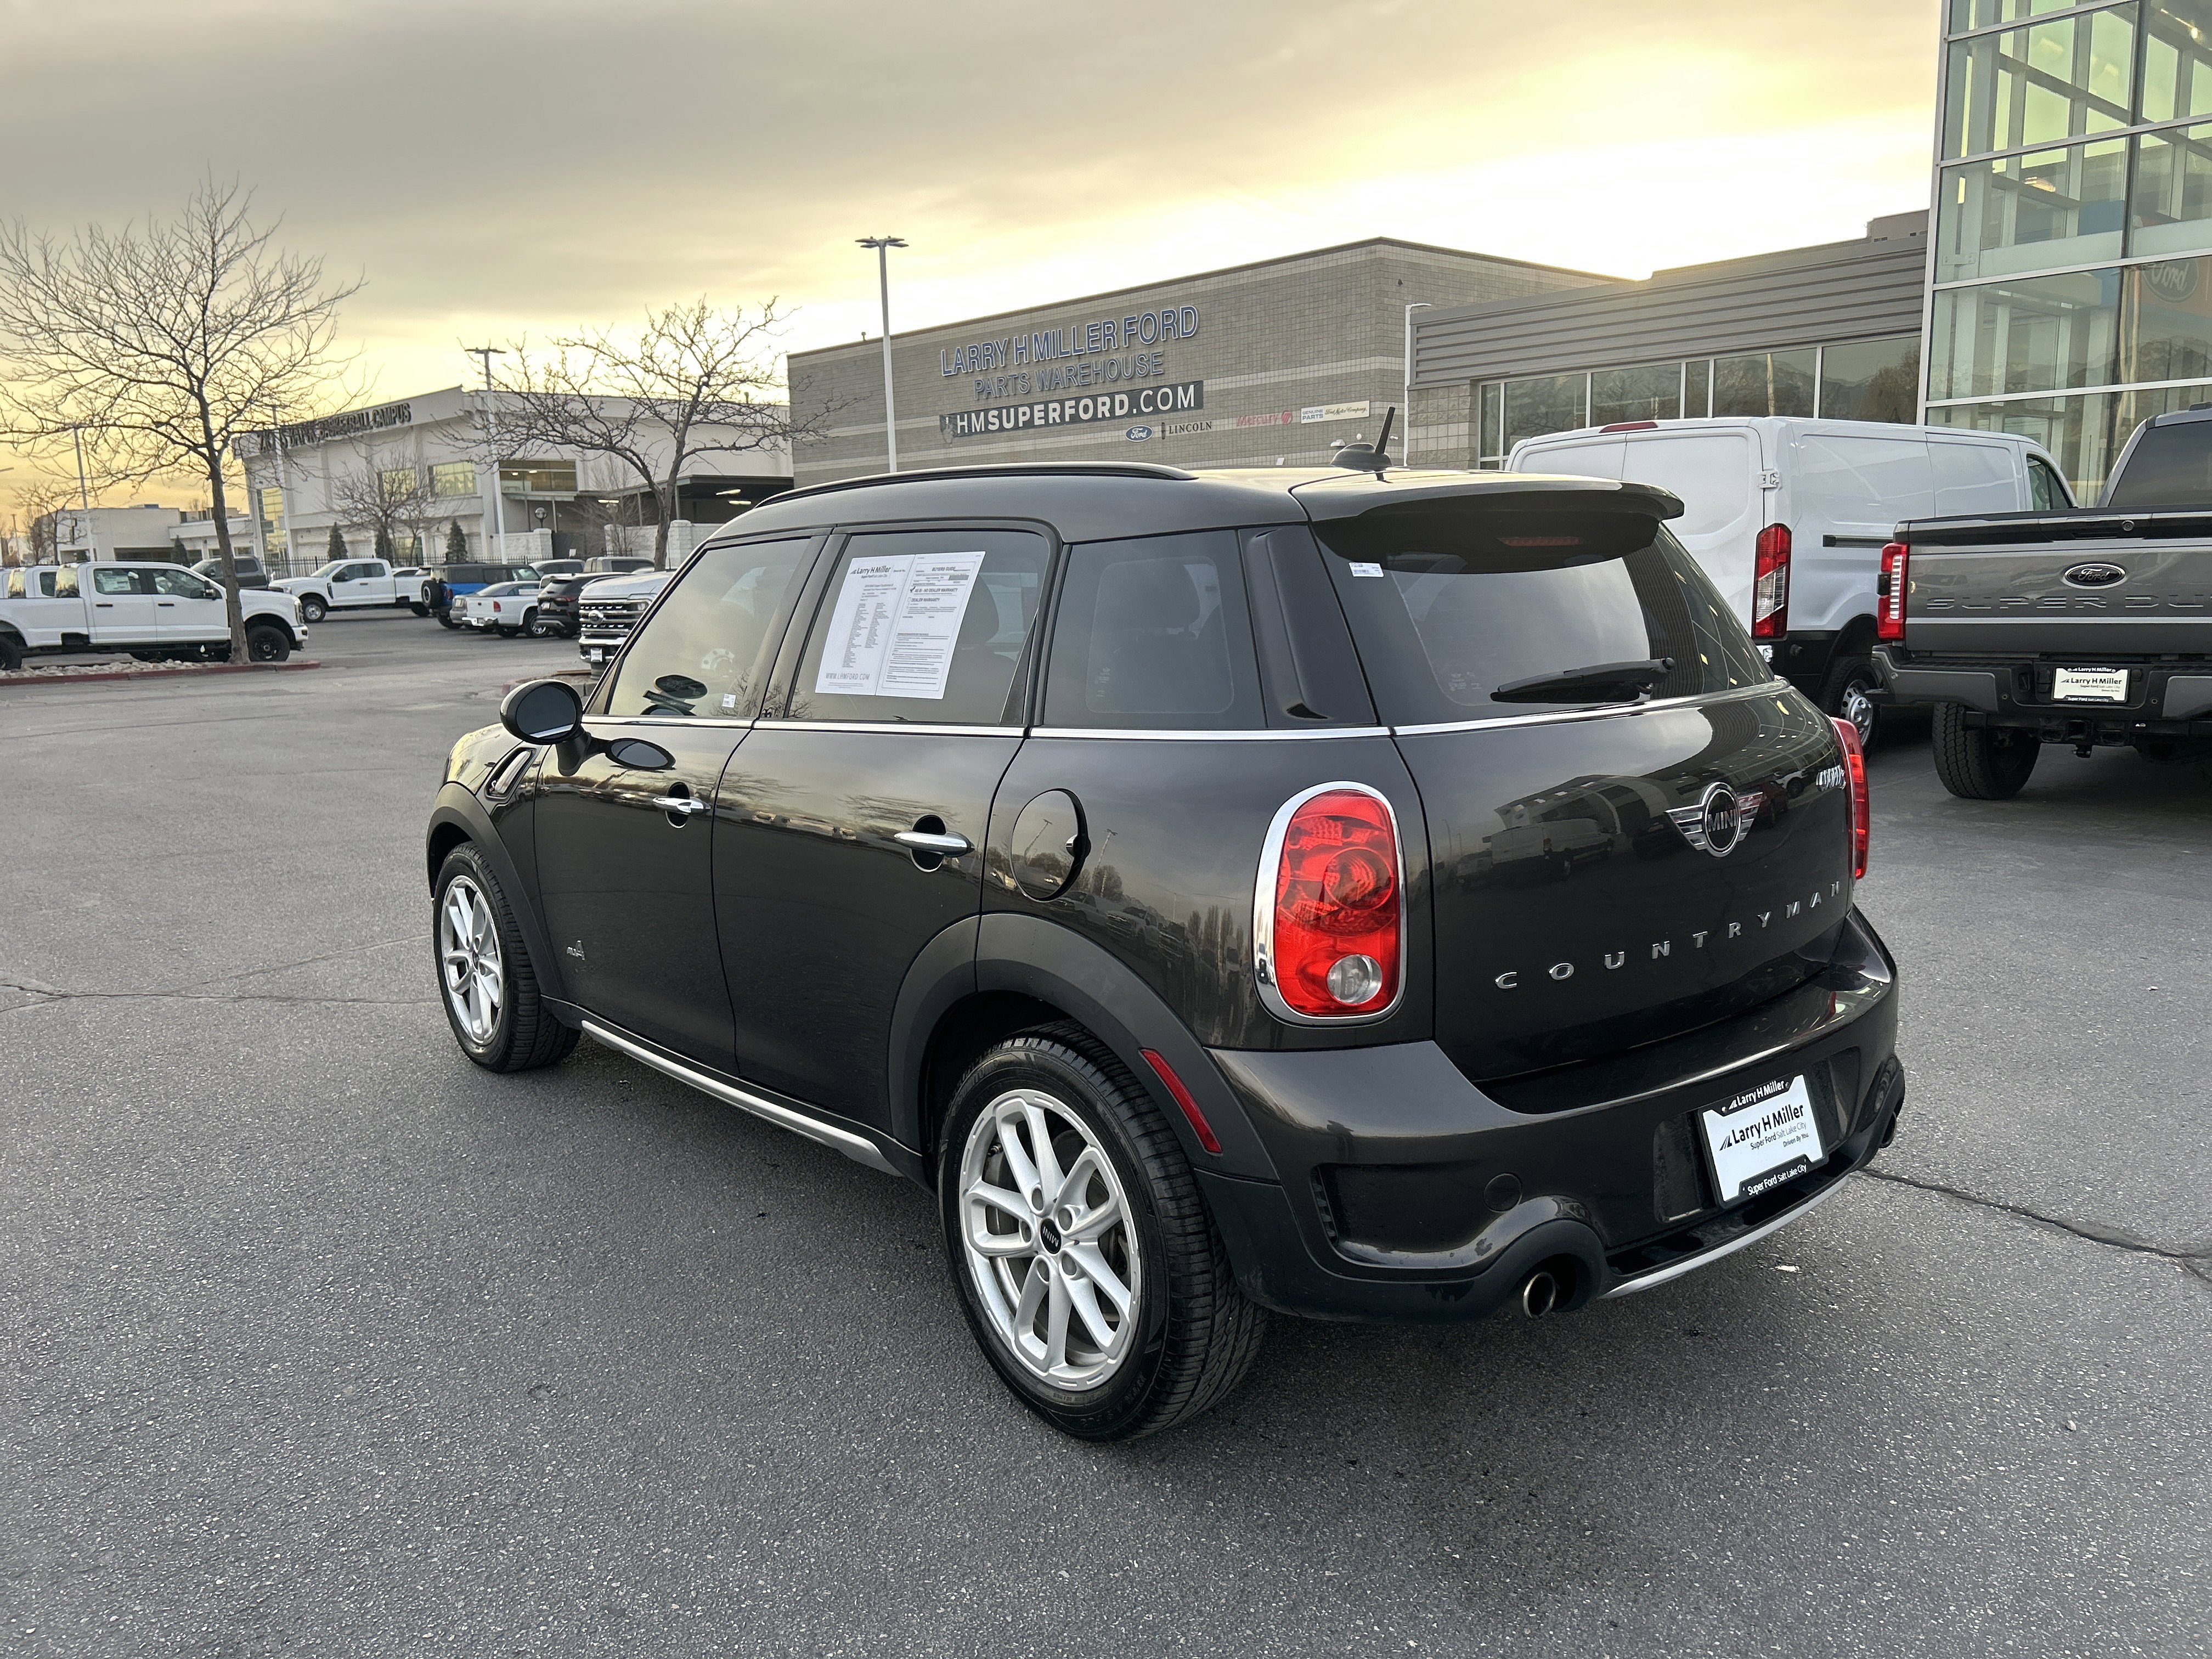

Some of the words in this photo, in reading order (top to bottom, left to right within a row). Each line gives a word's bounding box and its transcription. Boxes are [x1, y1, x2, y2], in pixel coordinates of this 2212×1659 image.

[941, 338, 1008, 377] LARRY
[1013, 334, 1029, 365] H
[1032, 319, 1118, 362] MILLER
[1122, 305, 1198, 347] FORD
[973, 371, 1030, 400] PARTS
[1034, 351, 1164, 391] WAREHOUSE
[371, 403, 412, 428] CAMPUS
[1169, 421, 1212, 435] LINCOLN
[1130, 428, 1148, 438] Ford
[2078, 568, 2111, 581] Ford
[1927, 596, 2107, 610] SUPER
[2125, 594, 2212, 608] DU
[1707, 809, 1736, 832] MINI
[1494, 880, 1840, 989] COUNTRYMAN
[1736, 1091, 1756, 1106] Larry
[1757, 1087, 1764, 1098] H
[1763, 1080, 1784, 1096] Miller
[1731, 1122, 1760, 1144] Larry
[1762, 1115, 1772, 1132] H
[1772, 1104, 1804, 1128] Miller
[1750, 1139, 1765, 1150] Super
[1765, 1132, 1777, 1144] Ford
[1777, 1128, 1786, 1139] Salt
[1785, 1125, 1797, 1136] Lake
[1797, 1121, 1807, 1130] City
[1783, 1137, 1796, 1148] Driven
[1747, 1182, 1764, 1196] Super
[1763, 1174, 1778, 1188] Ford
[1778, 1172, 1788, 1182] Salt
[1786, 1168, 1798, 1178] Lake
[1797, 1164, 1807, 1173] City
[1042, 1226, 1059, 1248] MINI
